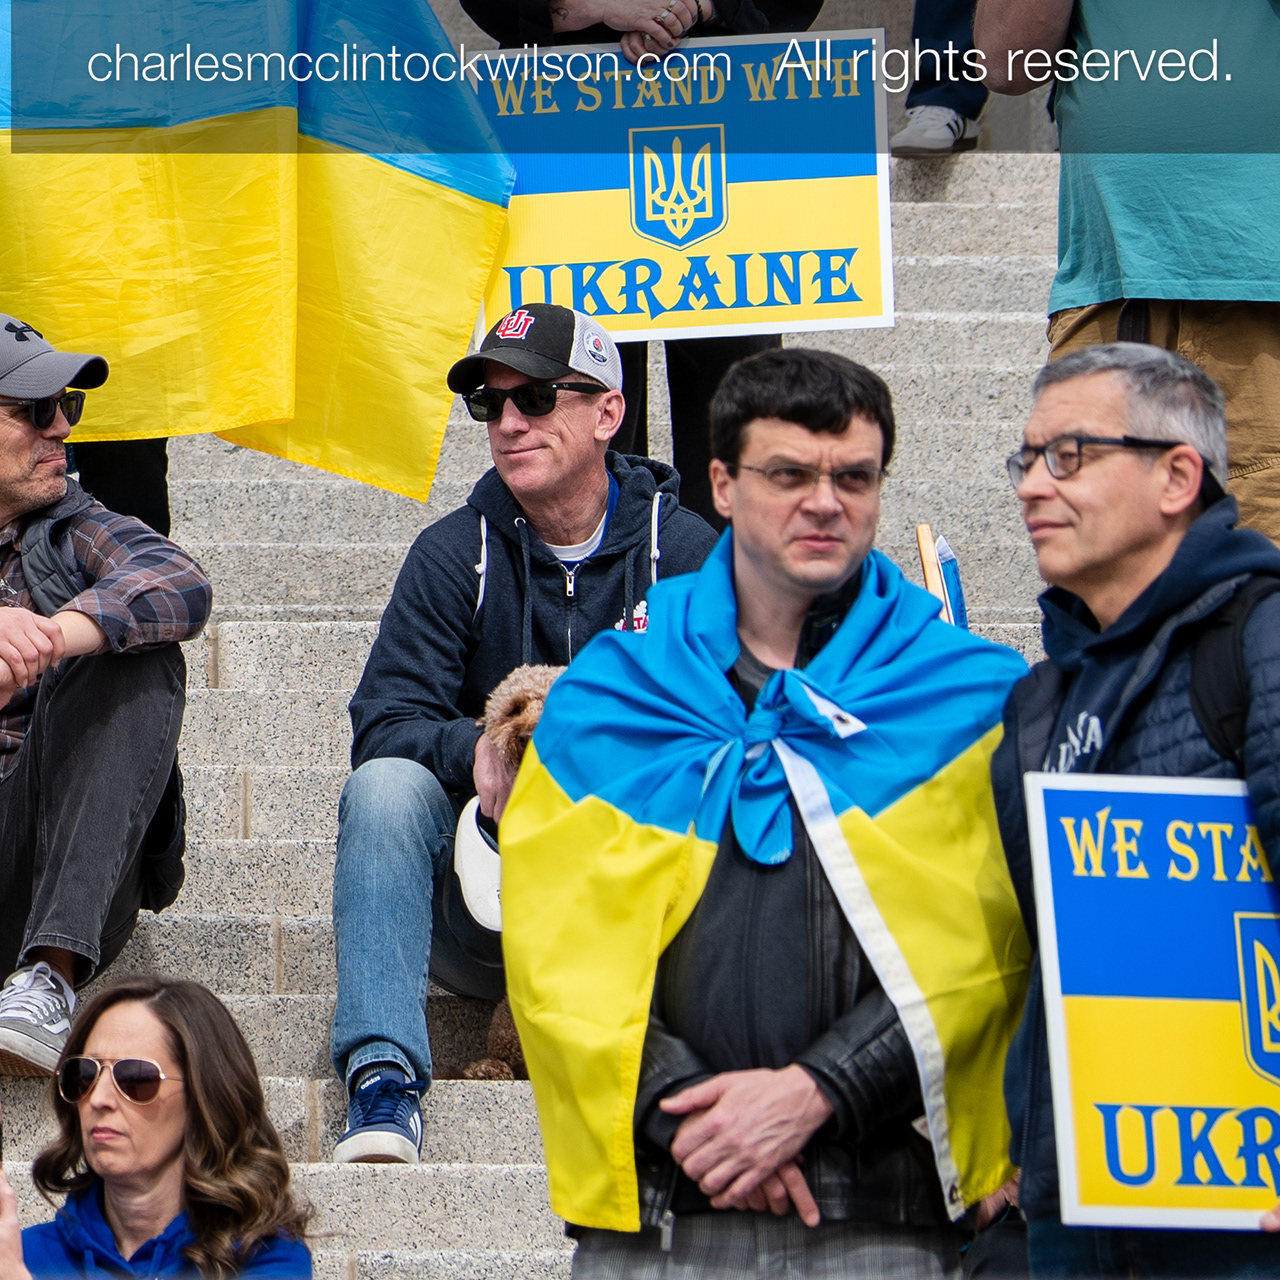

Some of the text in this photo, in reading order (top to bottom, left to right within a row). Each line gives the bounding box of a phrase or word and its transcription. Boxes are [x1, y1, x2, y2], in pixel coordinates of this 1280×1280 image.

[489, 53, 862, 117] WE STAND WITH
[501, 247, 865, 321] UKRAINE
[1059, 805, 1150, 879] WE
